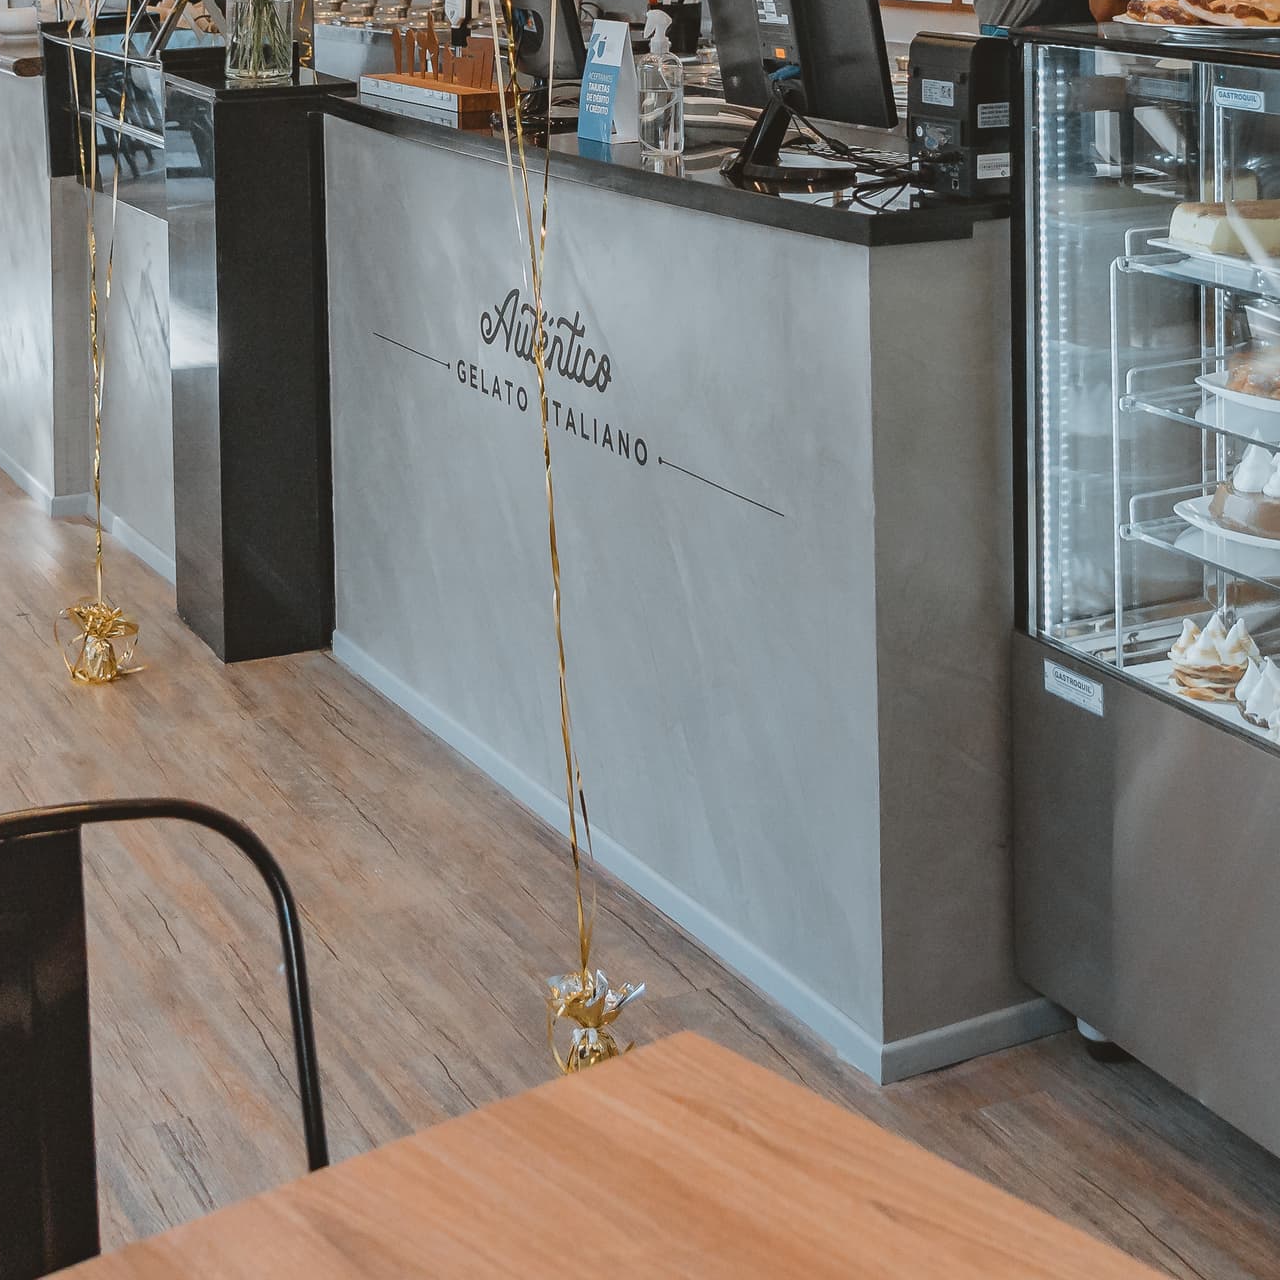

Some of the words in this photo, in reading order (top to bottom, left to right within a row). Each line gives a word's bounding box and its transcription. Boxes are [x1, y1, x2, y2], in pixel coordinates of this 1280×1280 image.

[588, 82, 610, 94] TARJETAS
[1218, 90, 1257, 103] GASTROQUIL
[457, 358, 528, 412] GELATO
[543, 397, 648, 467] ITALIANO
[1054, 670, 1092, 694] GASTROQUIL
